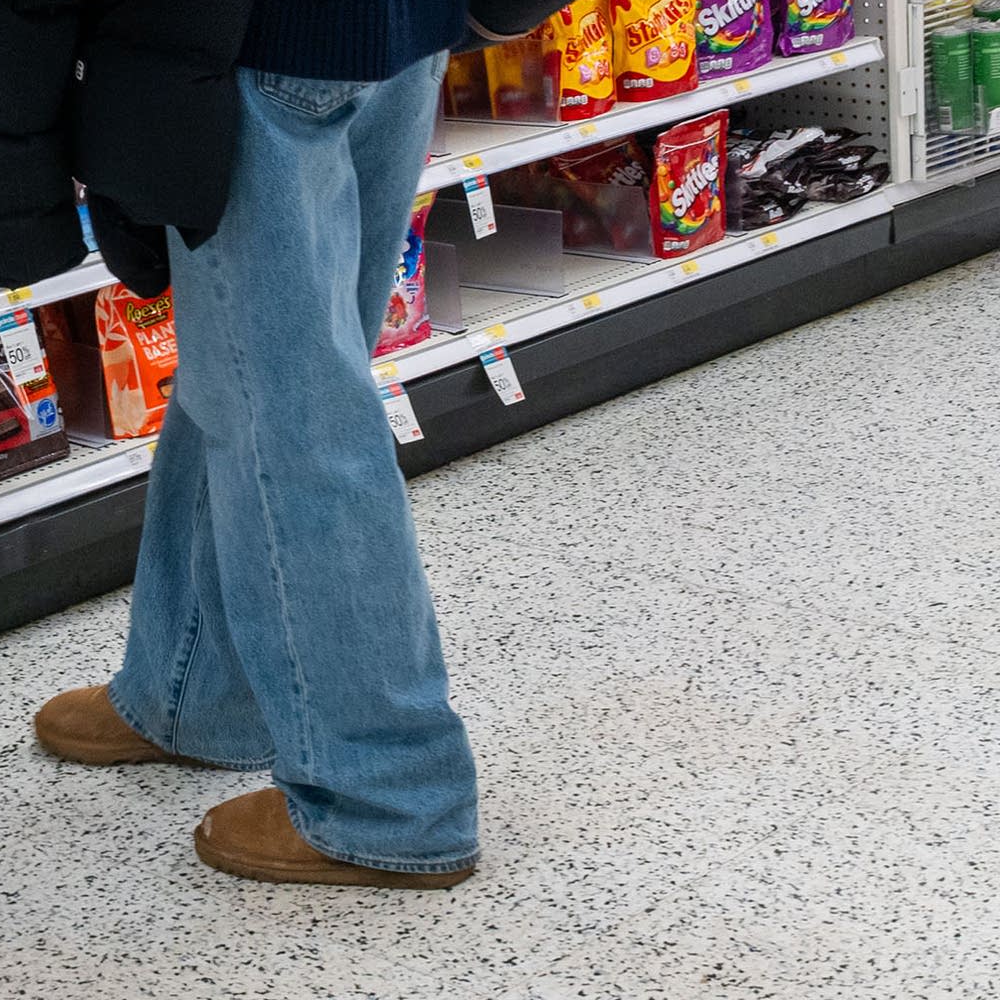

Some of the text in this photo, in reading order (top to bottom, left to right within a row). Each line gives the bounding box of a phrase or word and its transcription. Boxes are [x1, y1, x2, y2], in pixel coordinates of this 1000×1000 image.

[126, 296, 171, 321] Reese's
[135, 325, 175, 346] PLAN
[143, 341, 177, 361] BASE
